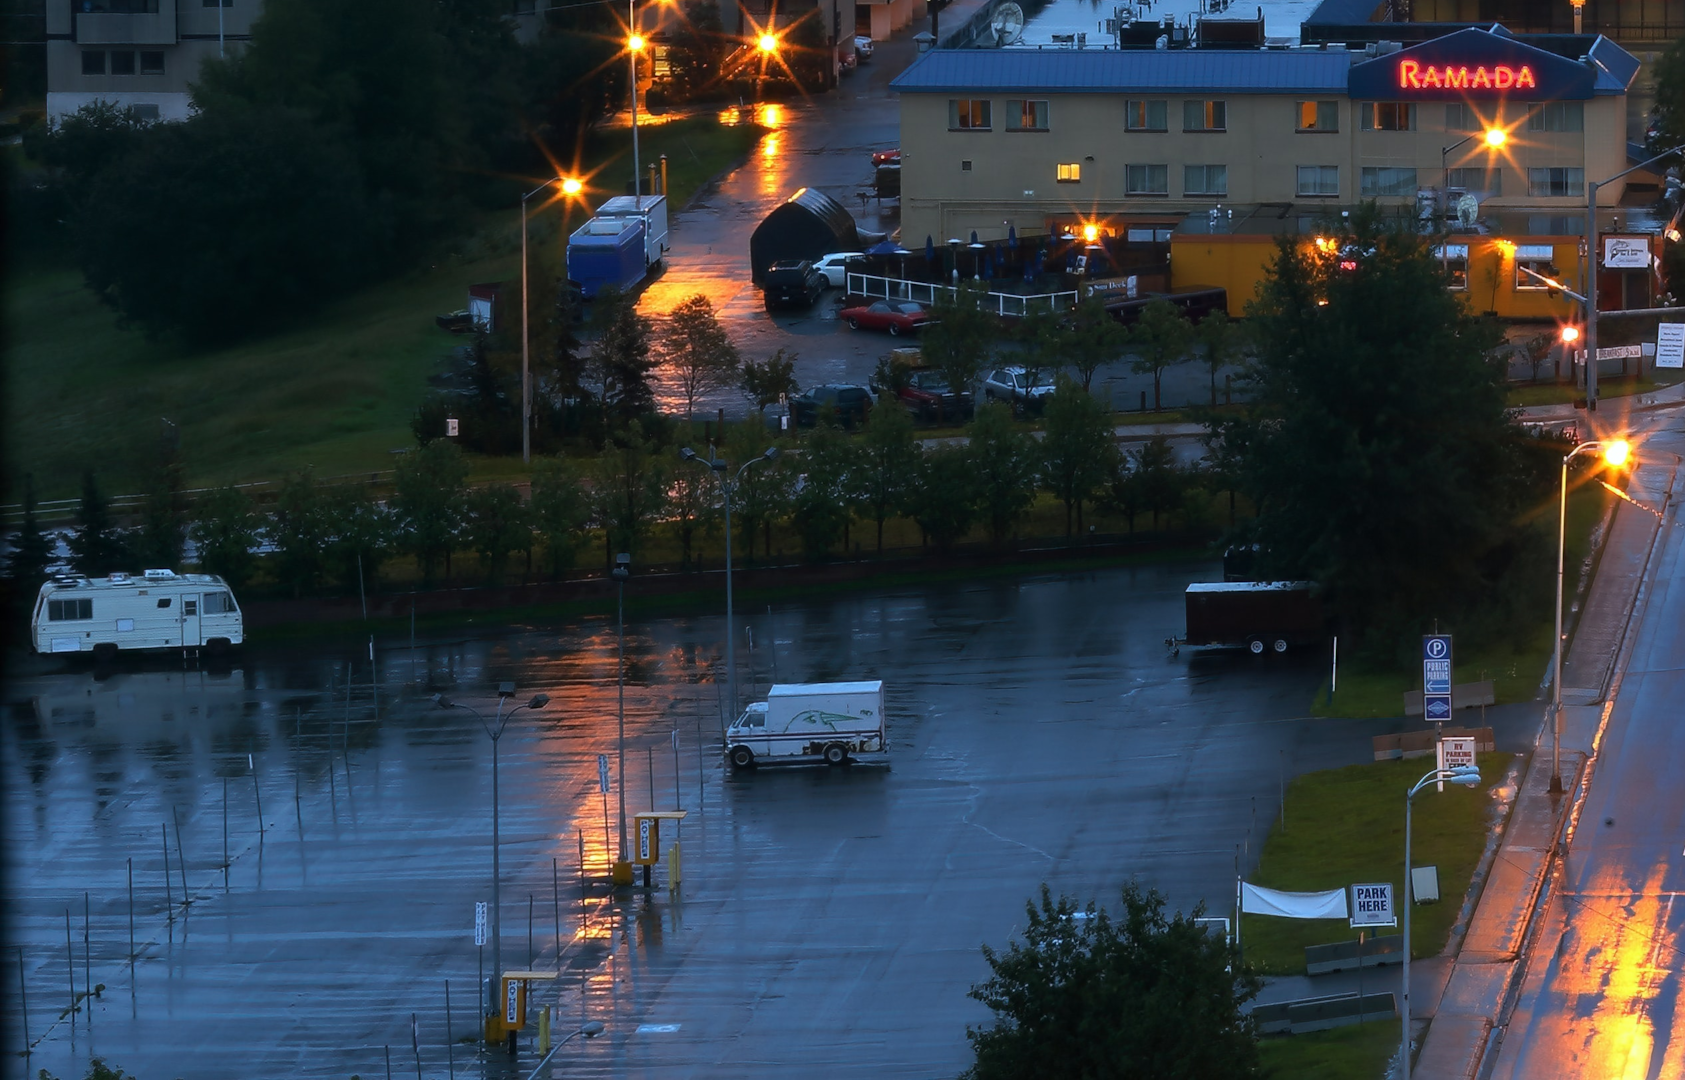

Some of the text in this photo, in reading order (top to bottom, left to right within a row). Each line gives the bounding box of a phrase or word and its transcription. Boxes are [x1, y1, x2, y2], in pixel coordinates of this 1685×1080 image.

[1400, 59, 1536, 89] RAMADA
[1433, 642, 1442, 655] P
[1427, 662, 1449, 671] PUBLIC
[1427, 671, 1449, 681] PARKING
[1357, 887, 1387, 899] PARK
[1358, 900, 1388, 912] HERE
